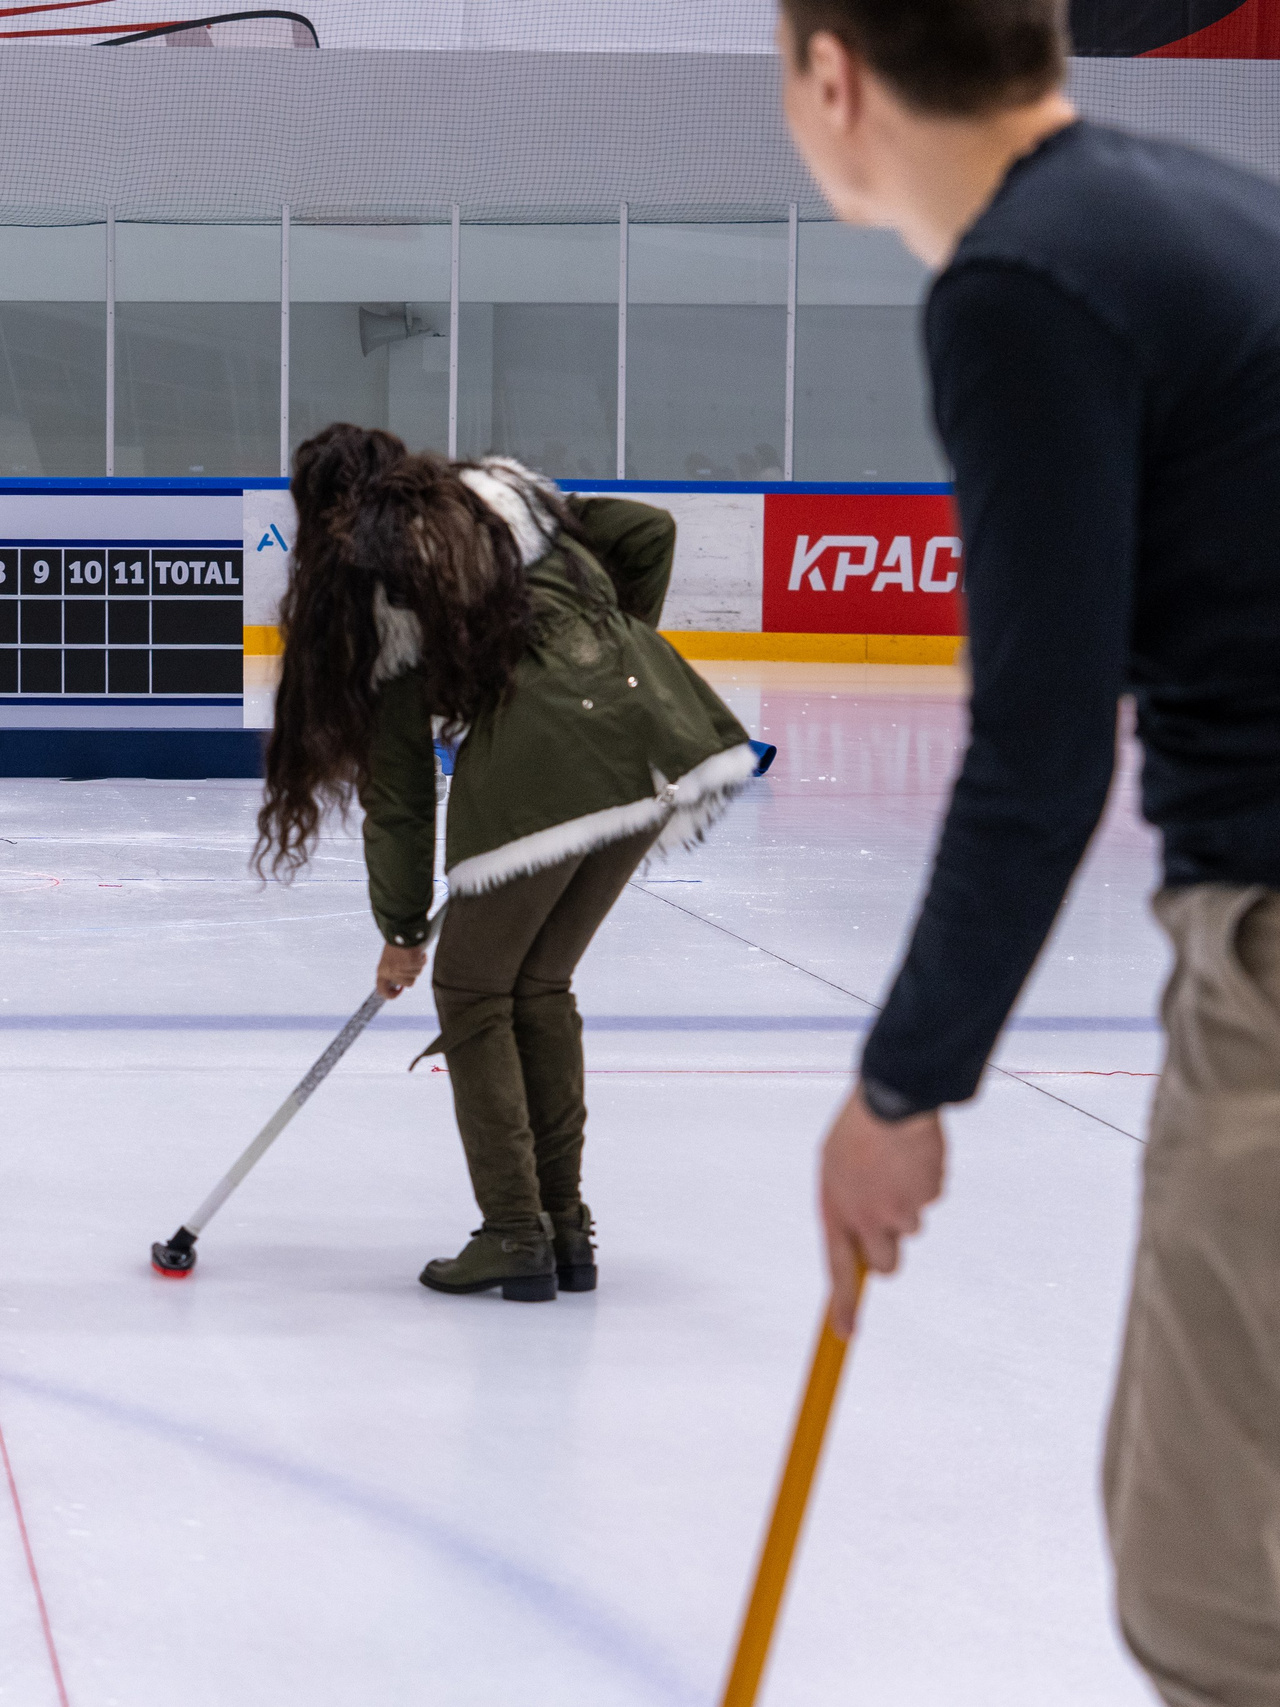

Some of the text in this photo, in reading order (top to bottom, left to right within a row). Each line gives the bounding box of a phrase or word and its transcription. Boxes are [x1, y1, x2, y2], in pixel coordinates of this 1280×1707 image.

[32, 560, 50, 584] 9
[69, 560, 103, 585] 10
[113, 560, 145, 585] 11
[154, 560, 240, 585] TOTAL
[787, 535, 966, 592] КРАС
